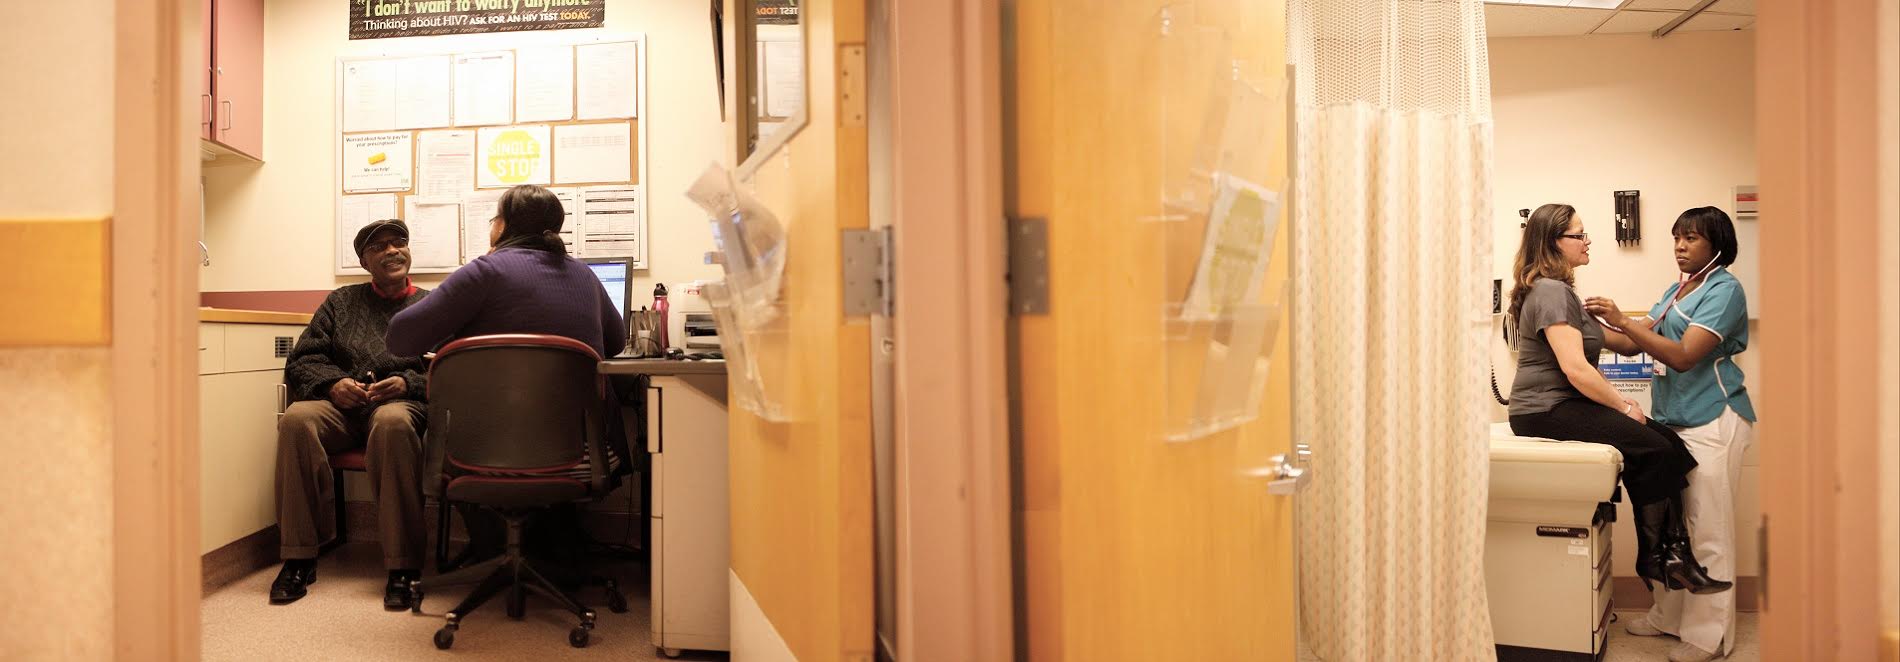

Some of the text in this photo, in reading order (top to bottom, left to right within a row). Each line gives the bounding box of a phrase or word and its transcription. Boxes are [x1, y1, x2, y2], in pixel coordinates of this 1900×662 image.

[415, 0, 451, 13] want
[456, 0, 471, 12] to
[475, 0, 519, 14] worry
[364, 19, 408, 30] Thinking
[410, 17, 443, 28] about
[443, 15, 468, 26] HIV?
[469, 17, 487, 25] ASK
[488, 16, 506, 24] FOR
[507, 15, 521, 23] AN
[522, 14, 538, 22] HIV
[540, 13, 558, 21] TEST
[560, 12, 591, 20] TODAY.
[495, 158, 543, 177] STOP
